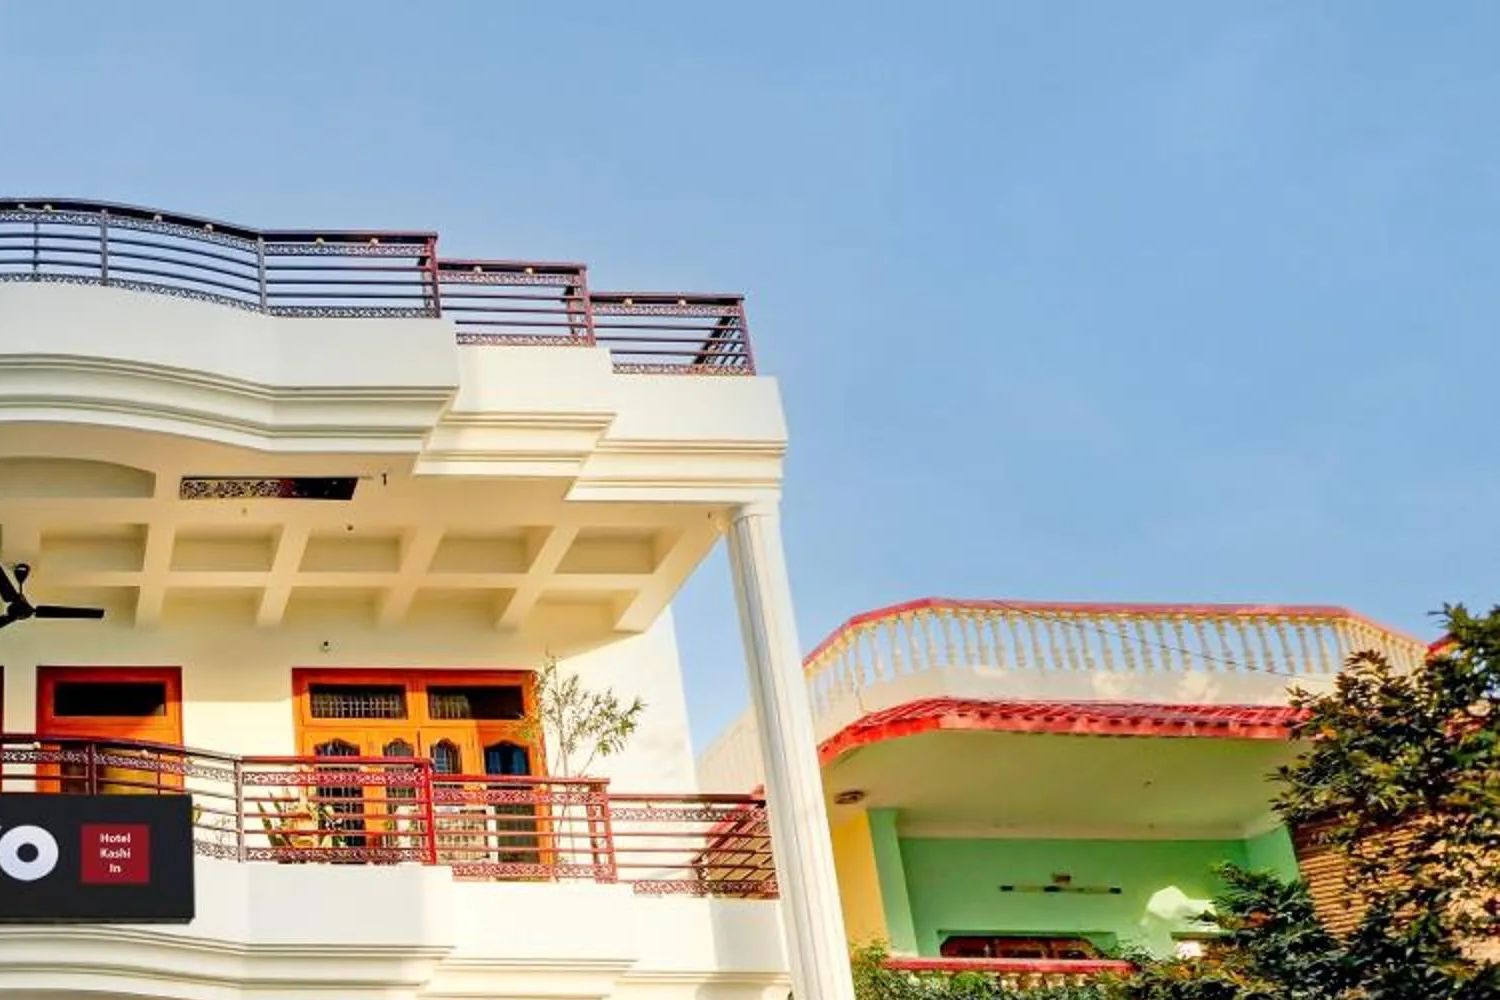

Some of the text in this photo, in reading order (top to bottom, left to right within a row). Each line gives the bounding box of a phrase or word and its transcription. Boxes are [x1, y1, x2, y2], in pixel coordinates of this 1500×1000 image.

[100, 832, 131, 843] Hotel
[100, 848, 131, 858] Kashi
[109, 863, 121, 872] In
